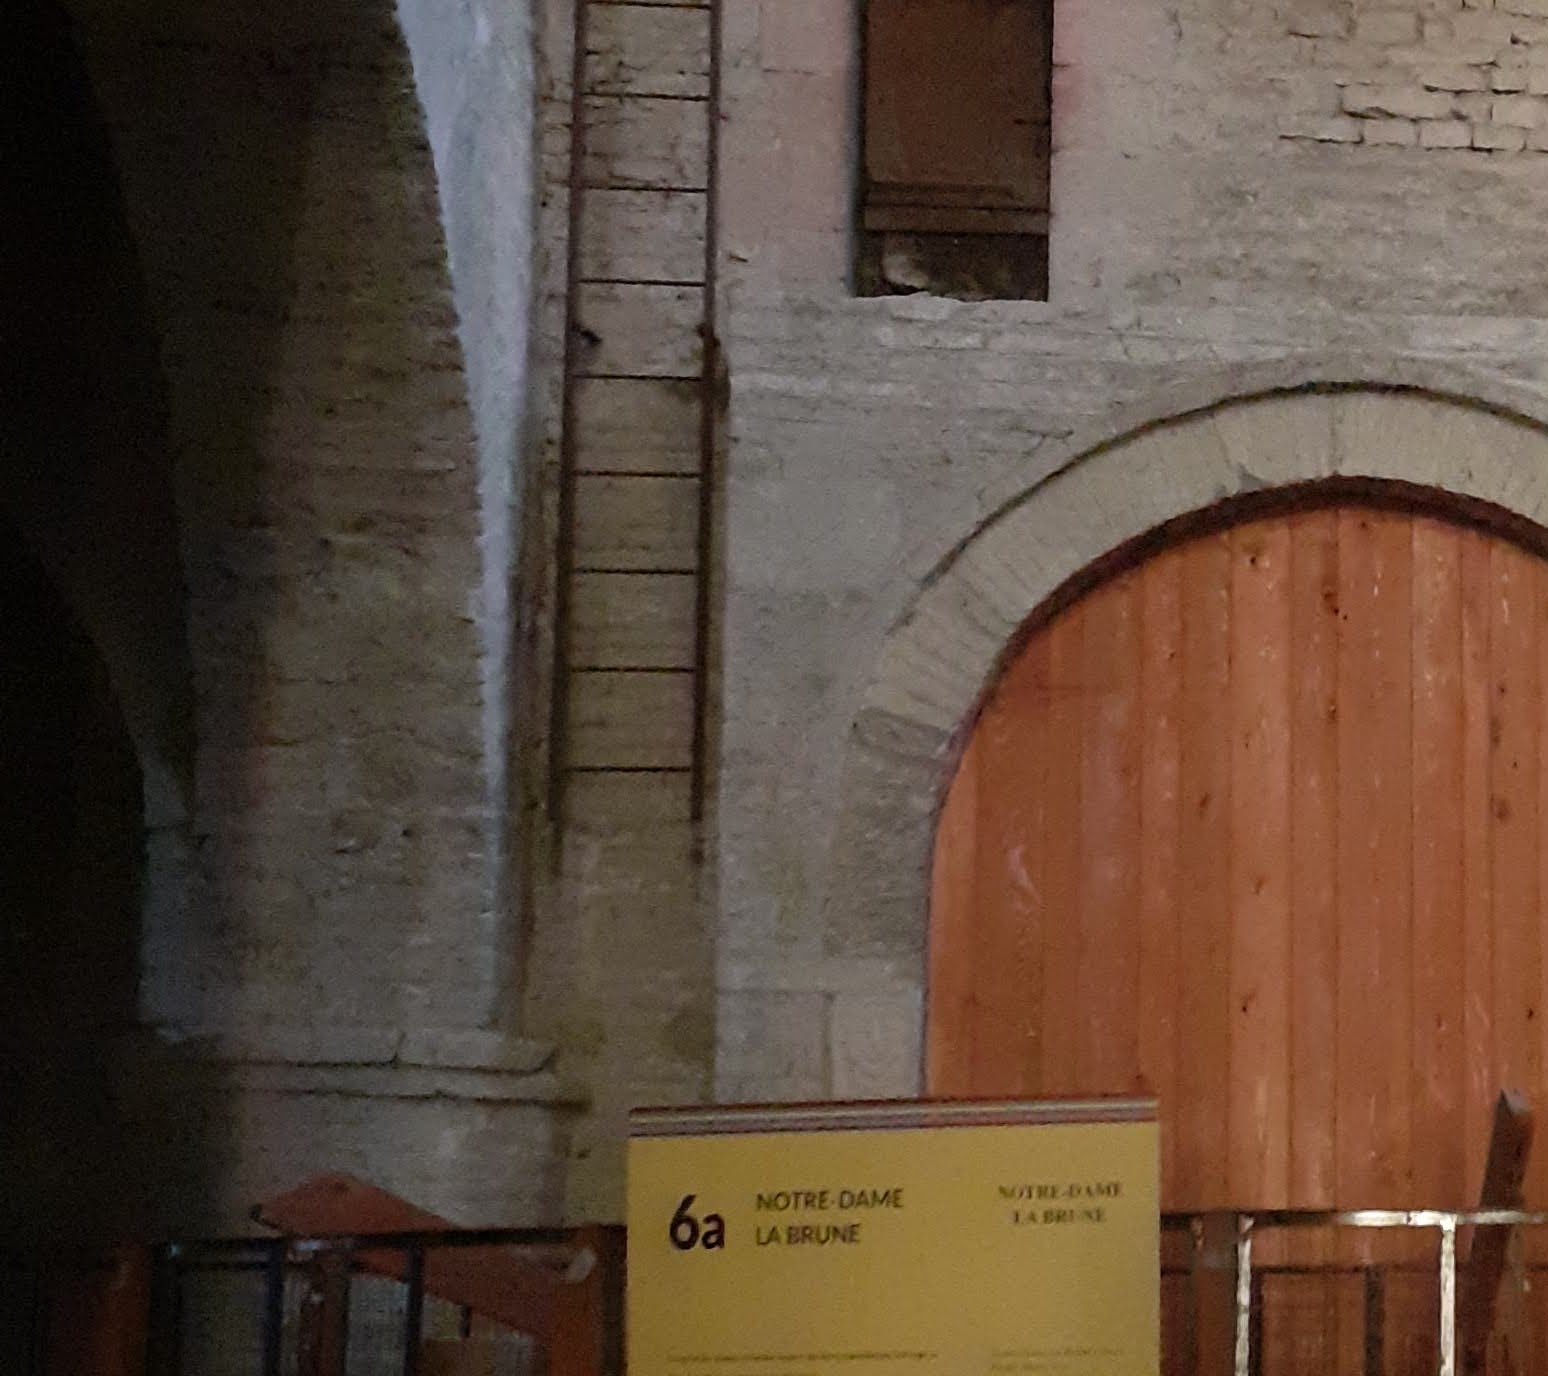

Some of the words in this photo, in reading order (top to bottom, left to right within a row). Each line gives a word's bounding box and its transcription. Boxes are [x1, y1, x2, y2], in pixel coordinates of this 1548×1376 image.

[756, 1188, 904, 1211] NOTRE-DAME
[669, 1195, 725, 1250] 6a
[756, 1228, 780, 1246] LA
[786, 1224, 861, 1246] BRUNE
